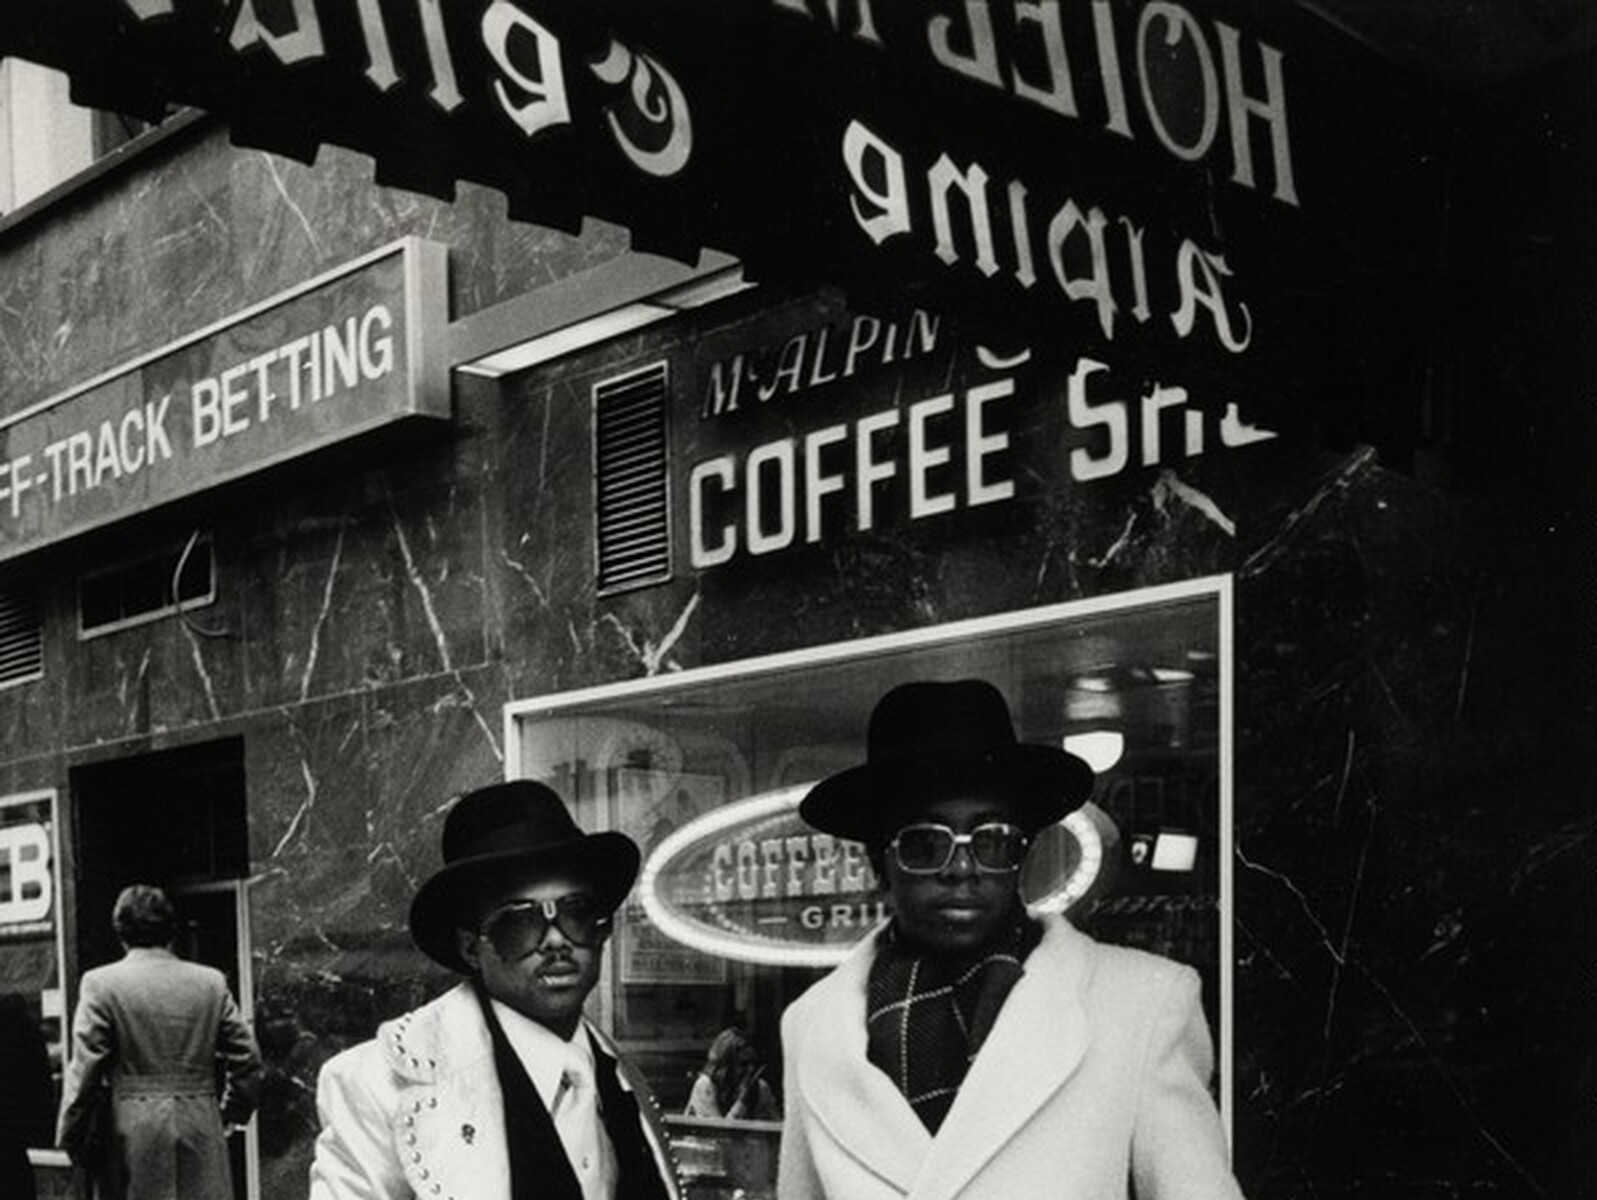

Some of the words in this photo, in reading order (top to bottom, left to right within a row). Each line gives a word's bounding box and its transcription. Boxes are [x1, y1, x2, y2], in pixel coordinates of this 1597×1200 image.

[192, 304, 394, 449] BETTING
[689, 378, 1016, 568] COFFEE
[713, 833, 867, 901] COFFEE
